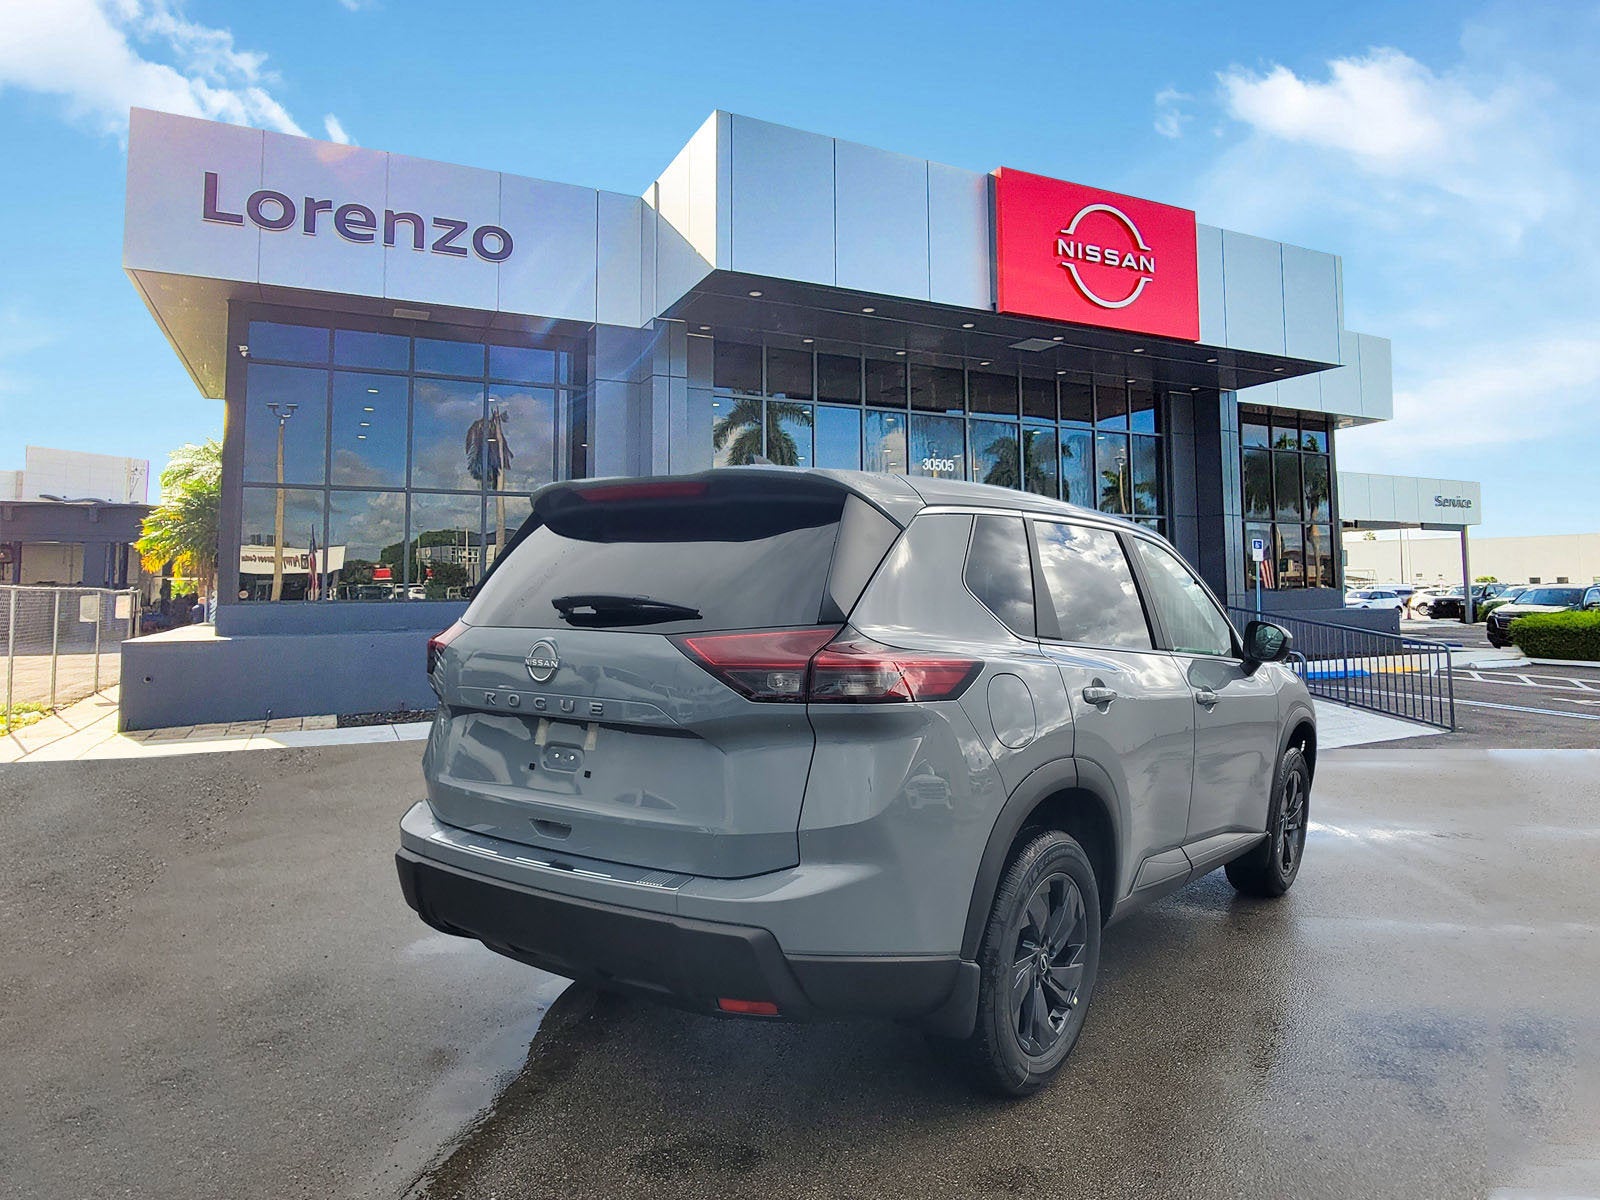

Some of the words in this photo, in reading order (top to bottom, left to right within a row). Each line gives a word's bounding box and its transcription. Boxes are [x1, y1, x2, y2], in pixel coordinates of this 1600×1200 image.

[202, 171, 514, 262] Lorenzo
[1057, 238, 1156, 273] NISSAN
[922, 458, 954, 471] 30505
[1434, 495, 1472, 509] Service
[525, 657, 559, 668] NISSAN
[484, 692, 604, 715] ROGUE
